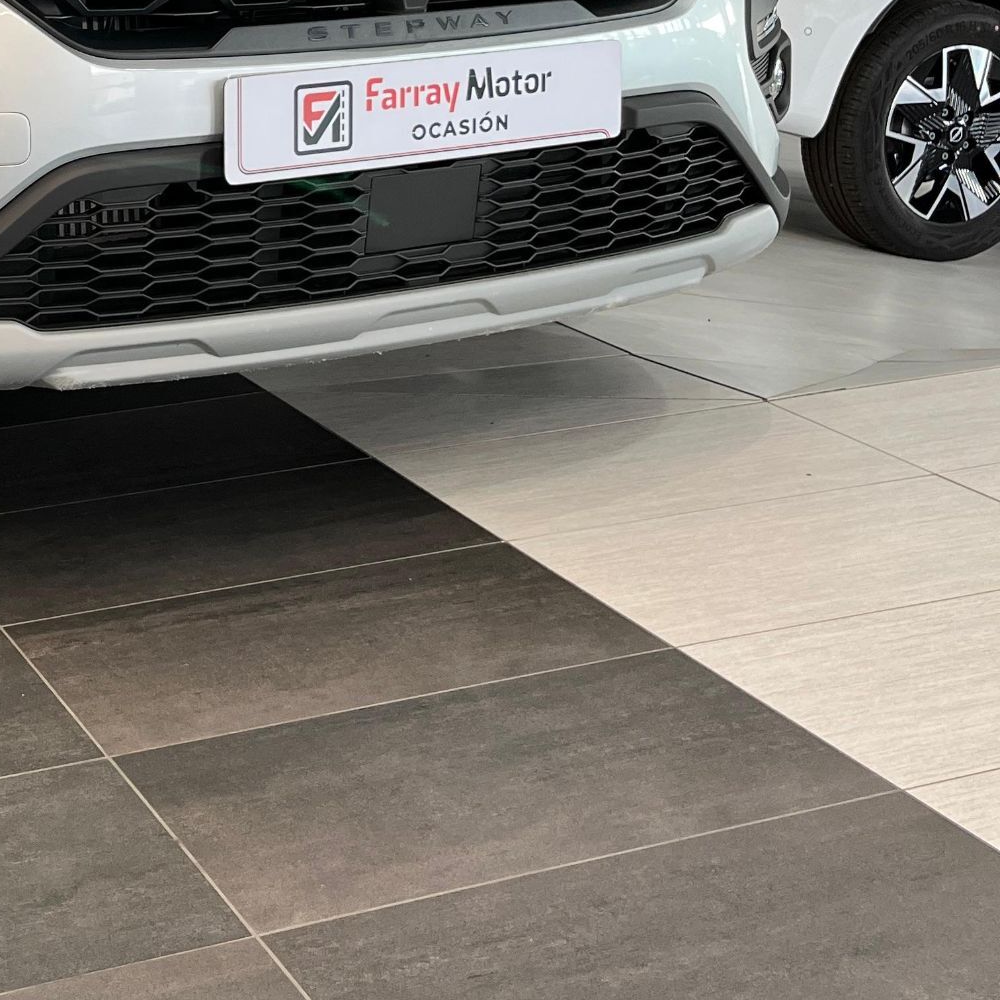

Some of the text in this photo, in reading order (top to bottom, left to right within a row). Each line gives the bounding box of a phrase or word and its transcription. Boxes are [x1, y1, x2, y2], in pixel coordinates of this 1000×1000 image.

[307, 10, 513, 42] STEPWAY
[366, 66, 552, 113] Farray Motor
[411, 111, 508, 141] OCASIÓN
